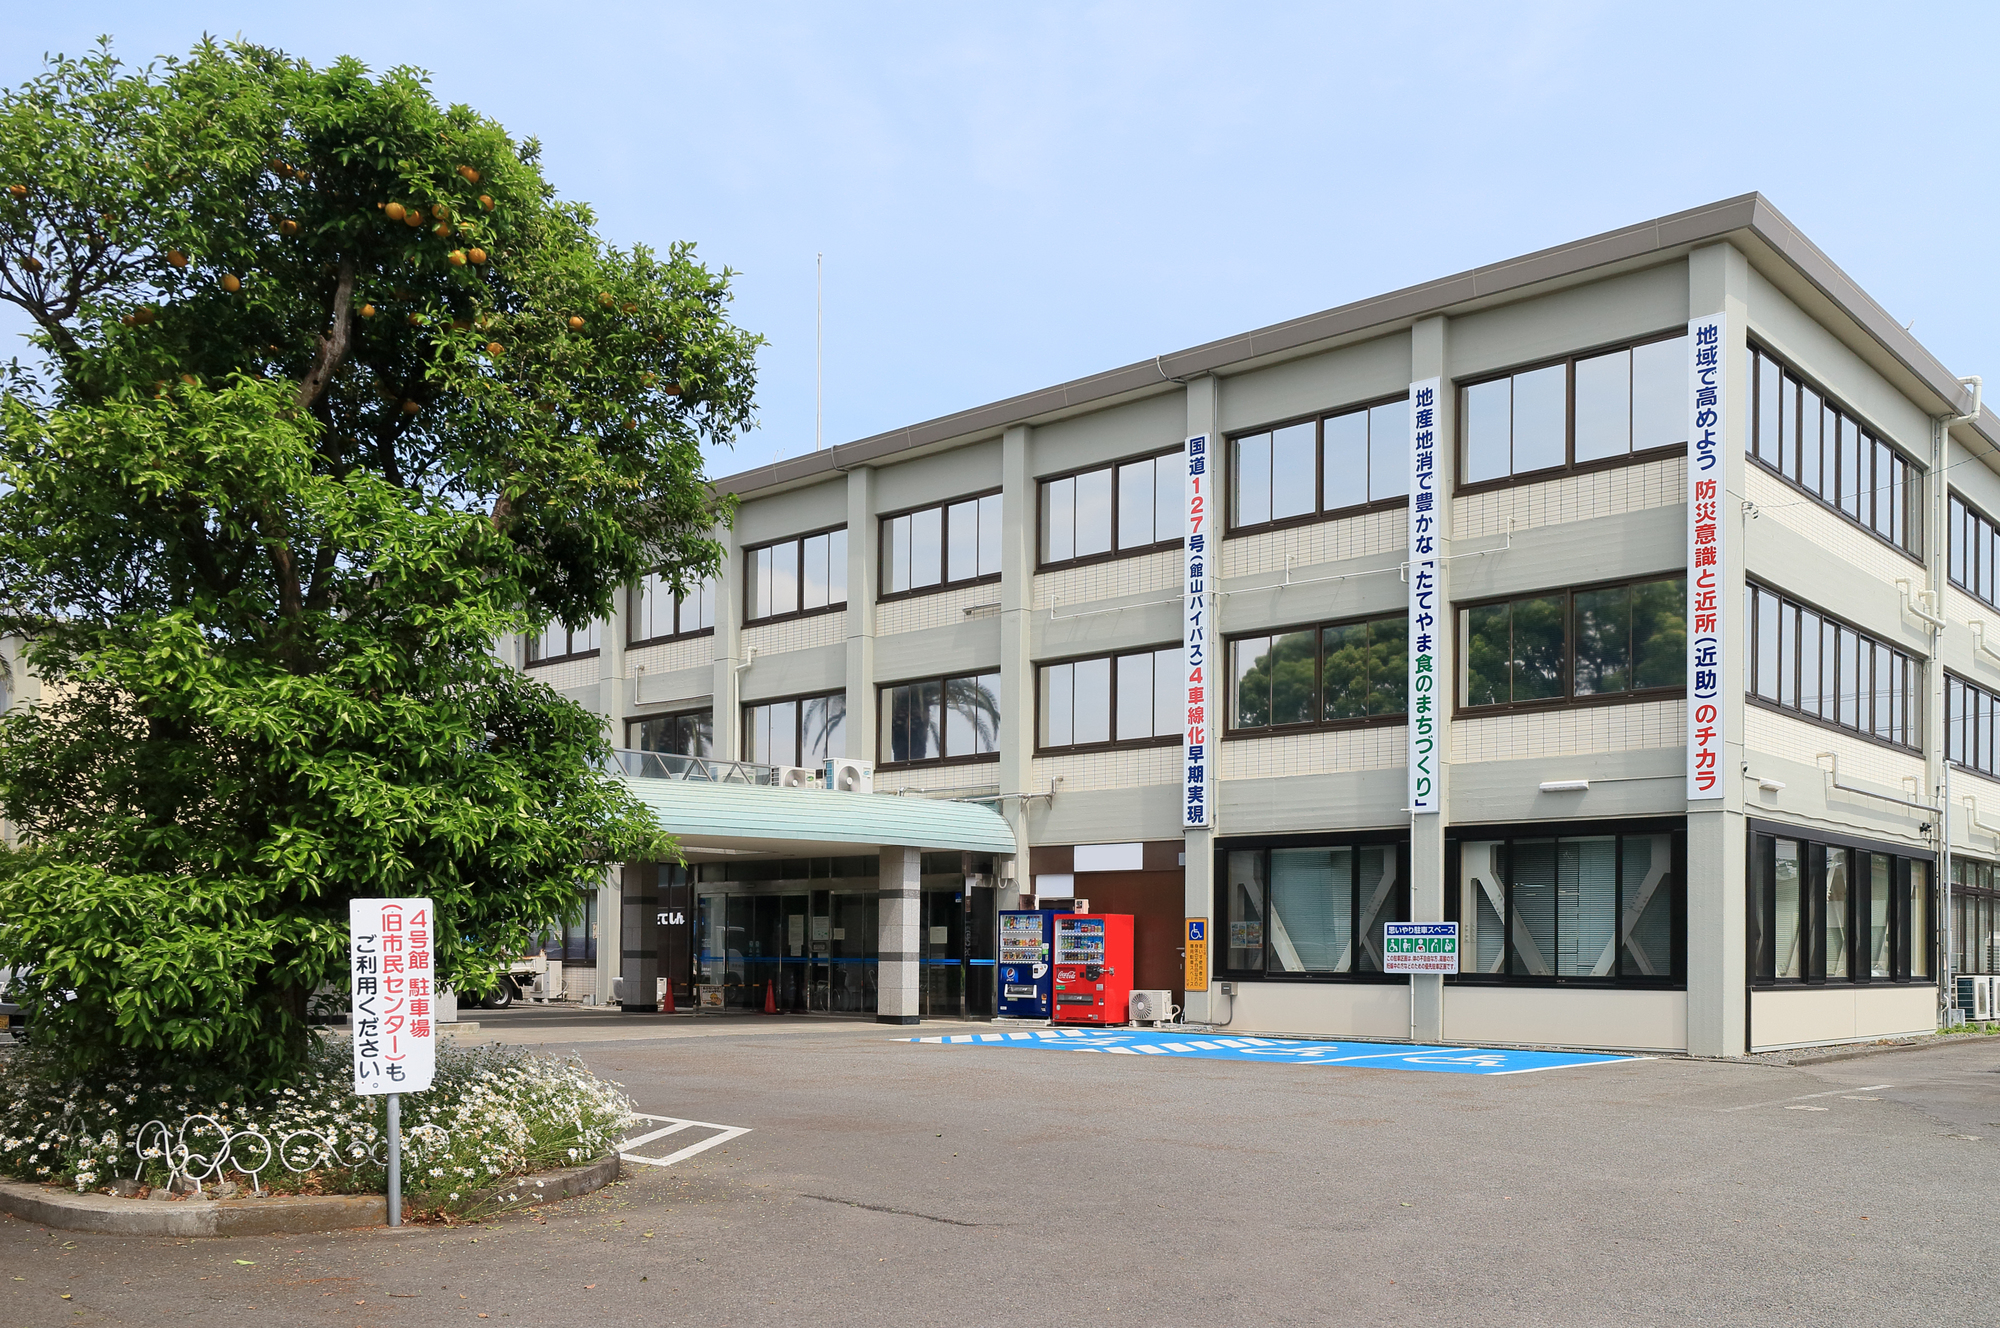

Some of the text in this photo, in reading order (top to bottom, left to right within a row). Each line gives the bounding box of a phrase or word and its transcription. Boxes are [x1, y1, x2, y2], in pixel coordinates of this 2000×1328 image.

[1415, 386, 1434, 807] 地産地消で豊かな「たてやま食のまちづくり」
[1694, 323, 1718, 791] 地域で高めよう 防災意識と近所（近助）のチカラ
[408, 909, 430, 1038] 4号館 駐車場
[1388, 926, 1455, 934] 思いやり駐車スペース
[356, 934, 380, 1088] ご利用ください。
